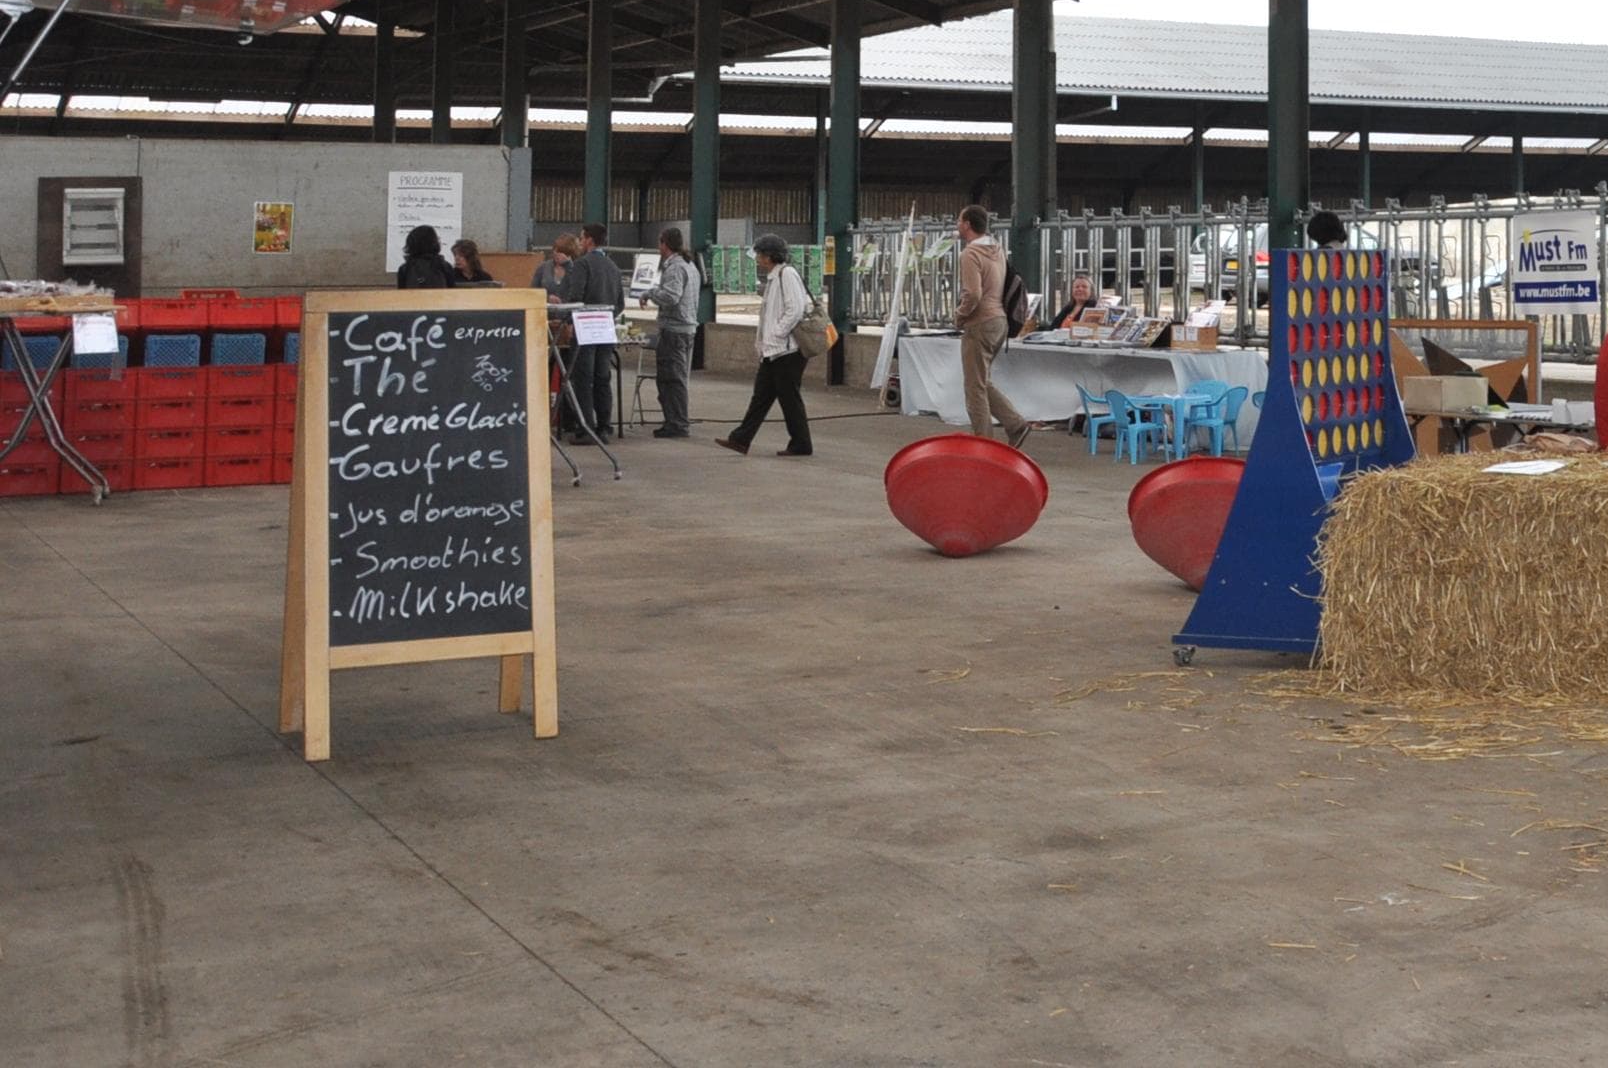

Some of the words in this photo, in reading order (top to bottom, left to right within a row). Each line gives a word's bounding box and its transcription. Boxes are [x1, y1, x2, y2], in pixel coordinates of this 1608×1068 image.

[1518, 235, 1562, 272] Must
[1518, 283, 1591, 299] www.mustfm.be
[345, 314, 447, 362] Café
[454, 326, 521, 345] expresso
[343, 355, 438, 398] Thé
[338, 443, 510, 485] Gaufres
[399, 492, 525, 526] d'orange
[355, 535, 523, 580] Smoothies
